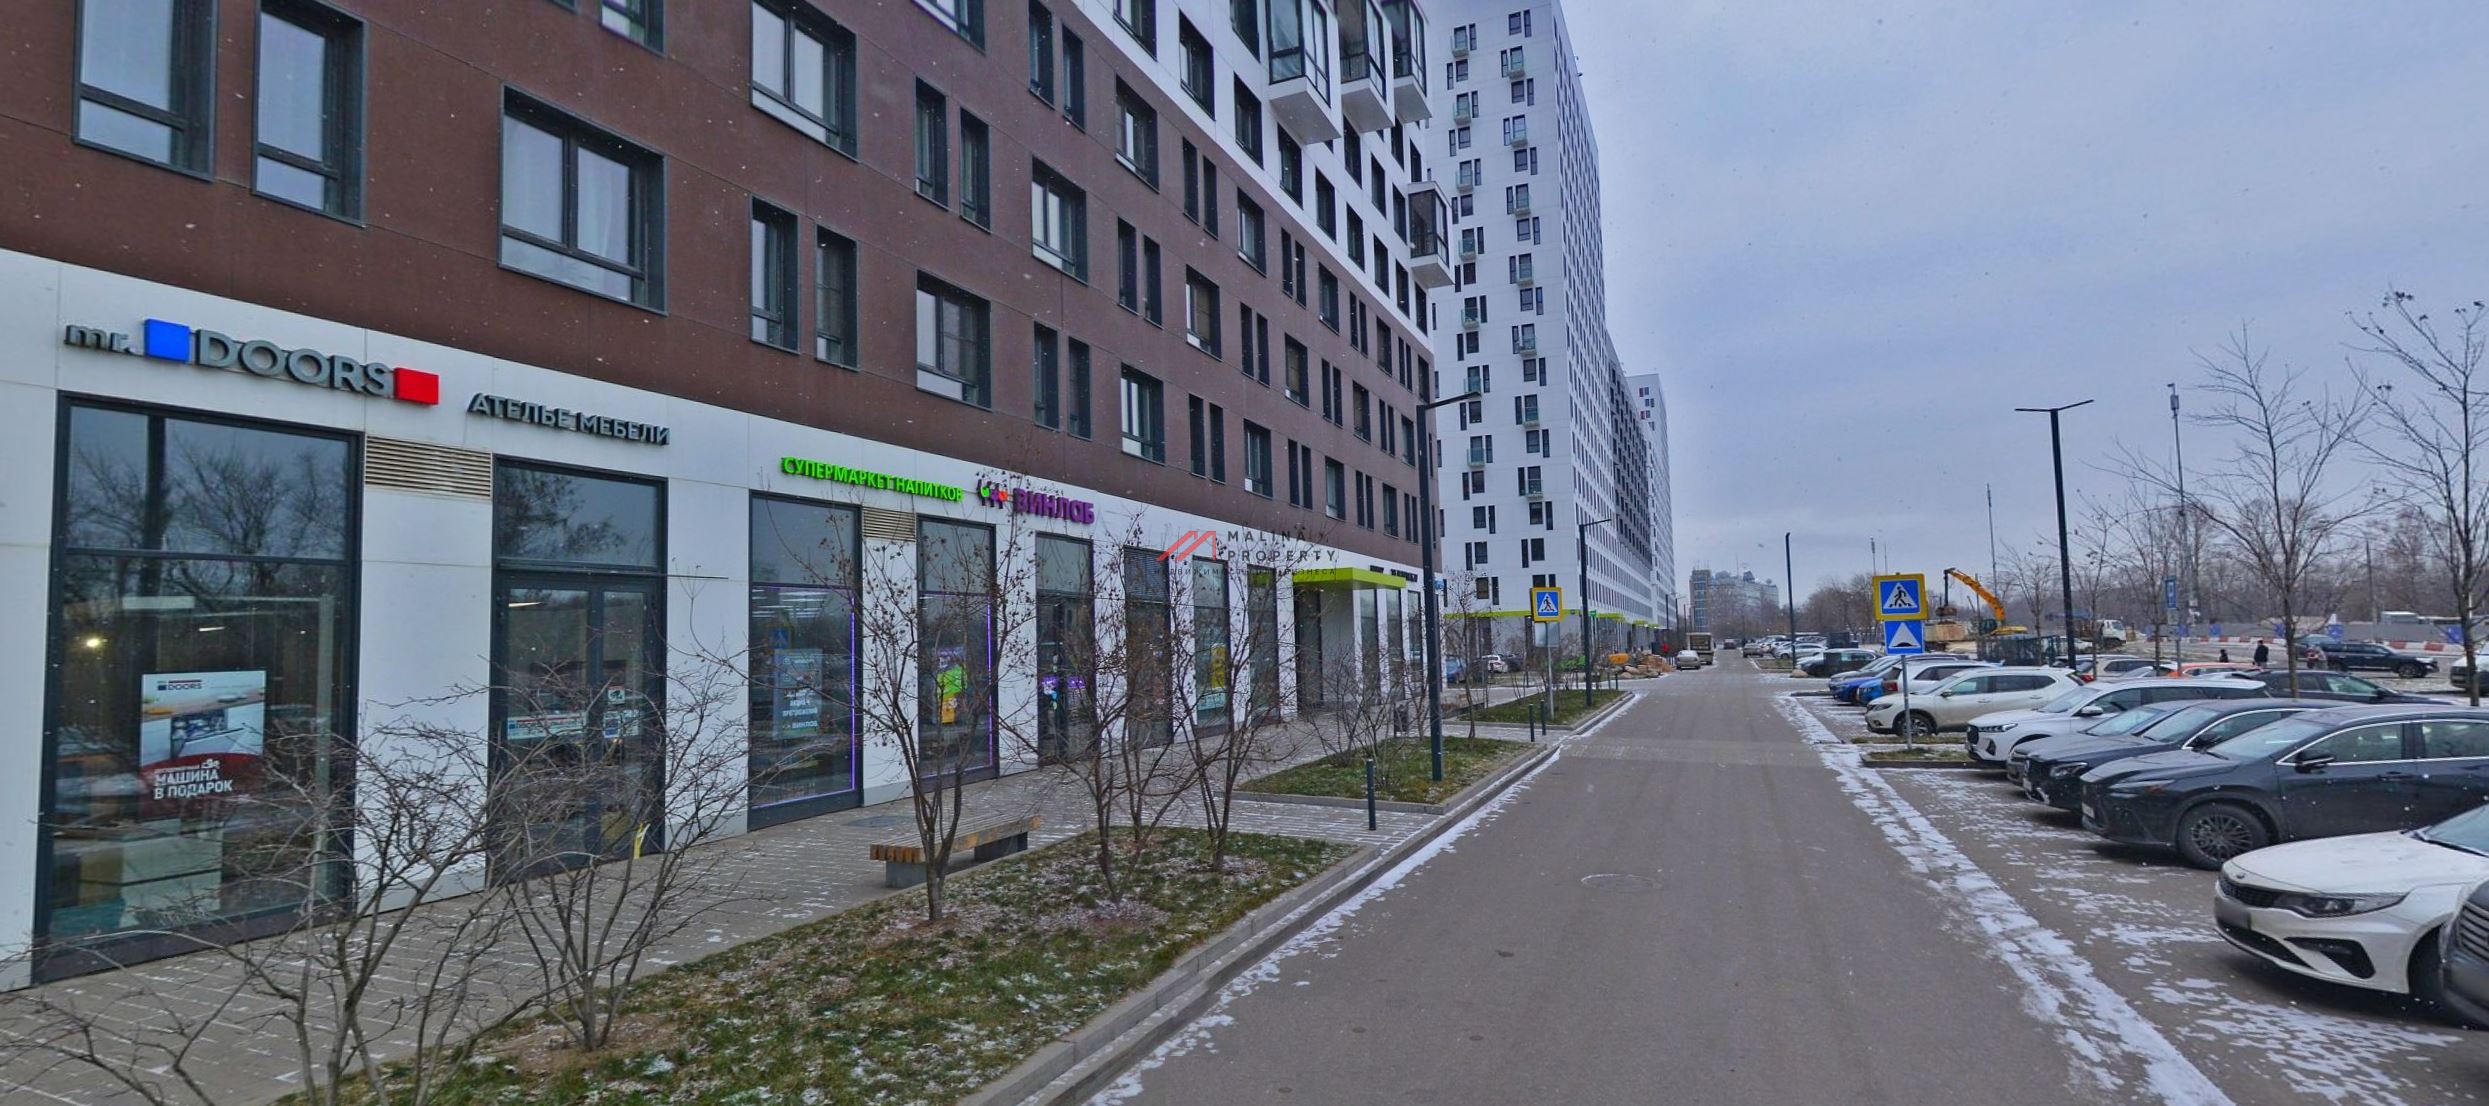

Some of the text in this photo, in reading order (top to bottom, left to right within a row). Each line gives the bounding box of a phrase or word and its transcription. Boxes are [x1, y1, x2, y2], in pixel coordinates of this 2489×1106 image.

[195, 328, 394, 397] DOORS
[467, 393, 671, 446] АТЕЛЬЕ МЕБЕЛИ
[781, 456, 964, 503] СУПЕРМАРКЕТ НАПИТКОВ
[154, 769, 219, 787] МАШИНА
[154, 780, 233, 800] В ПОДАРОК
